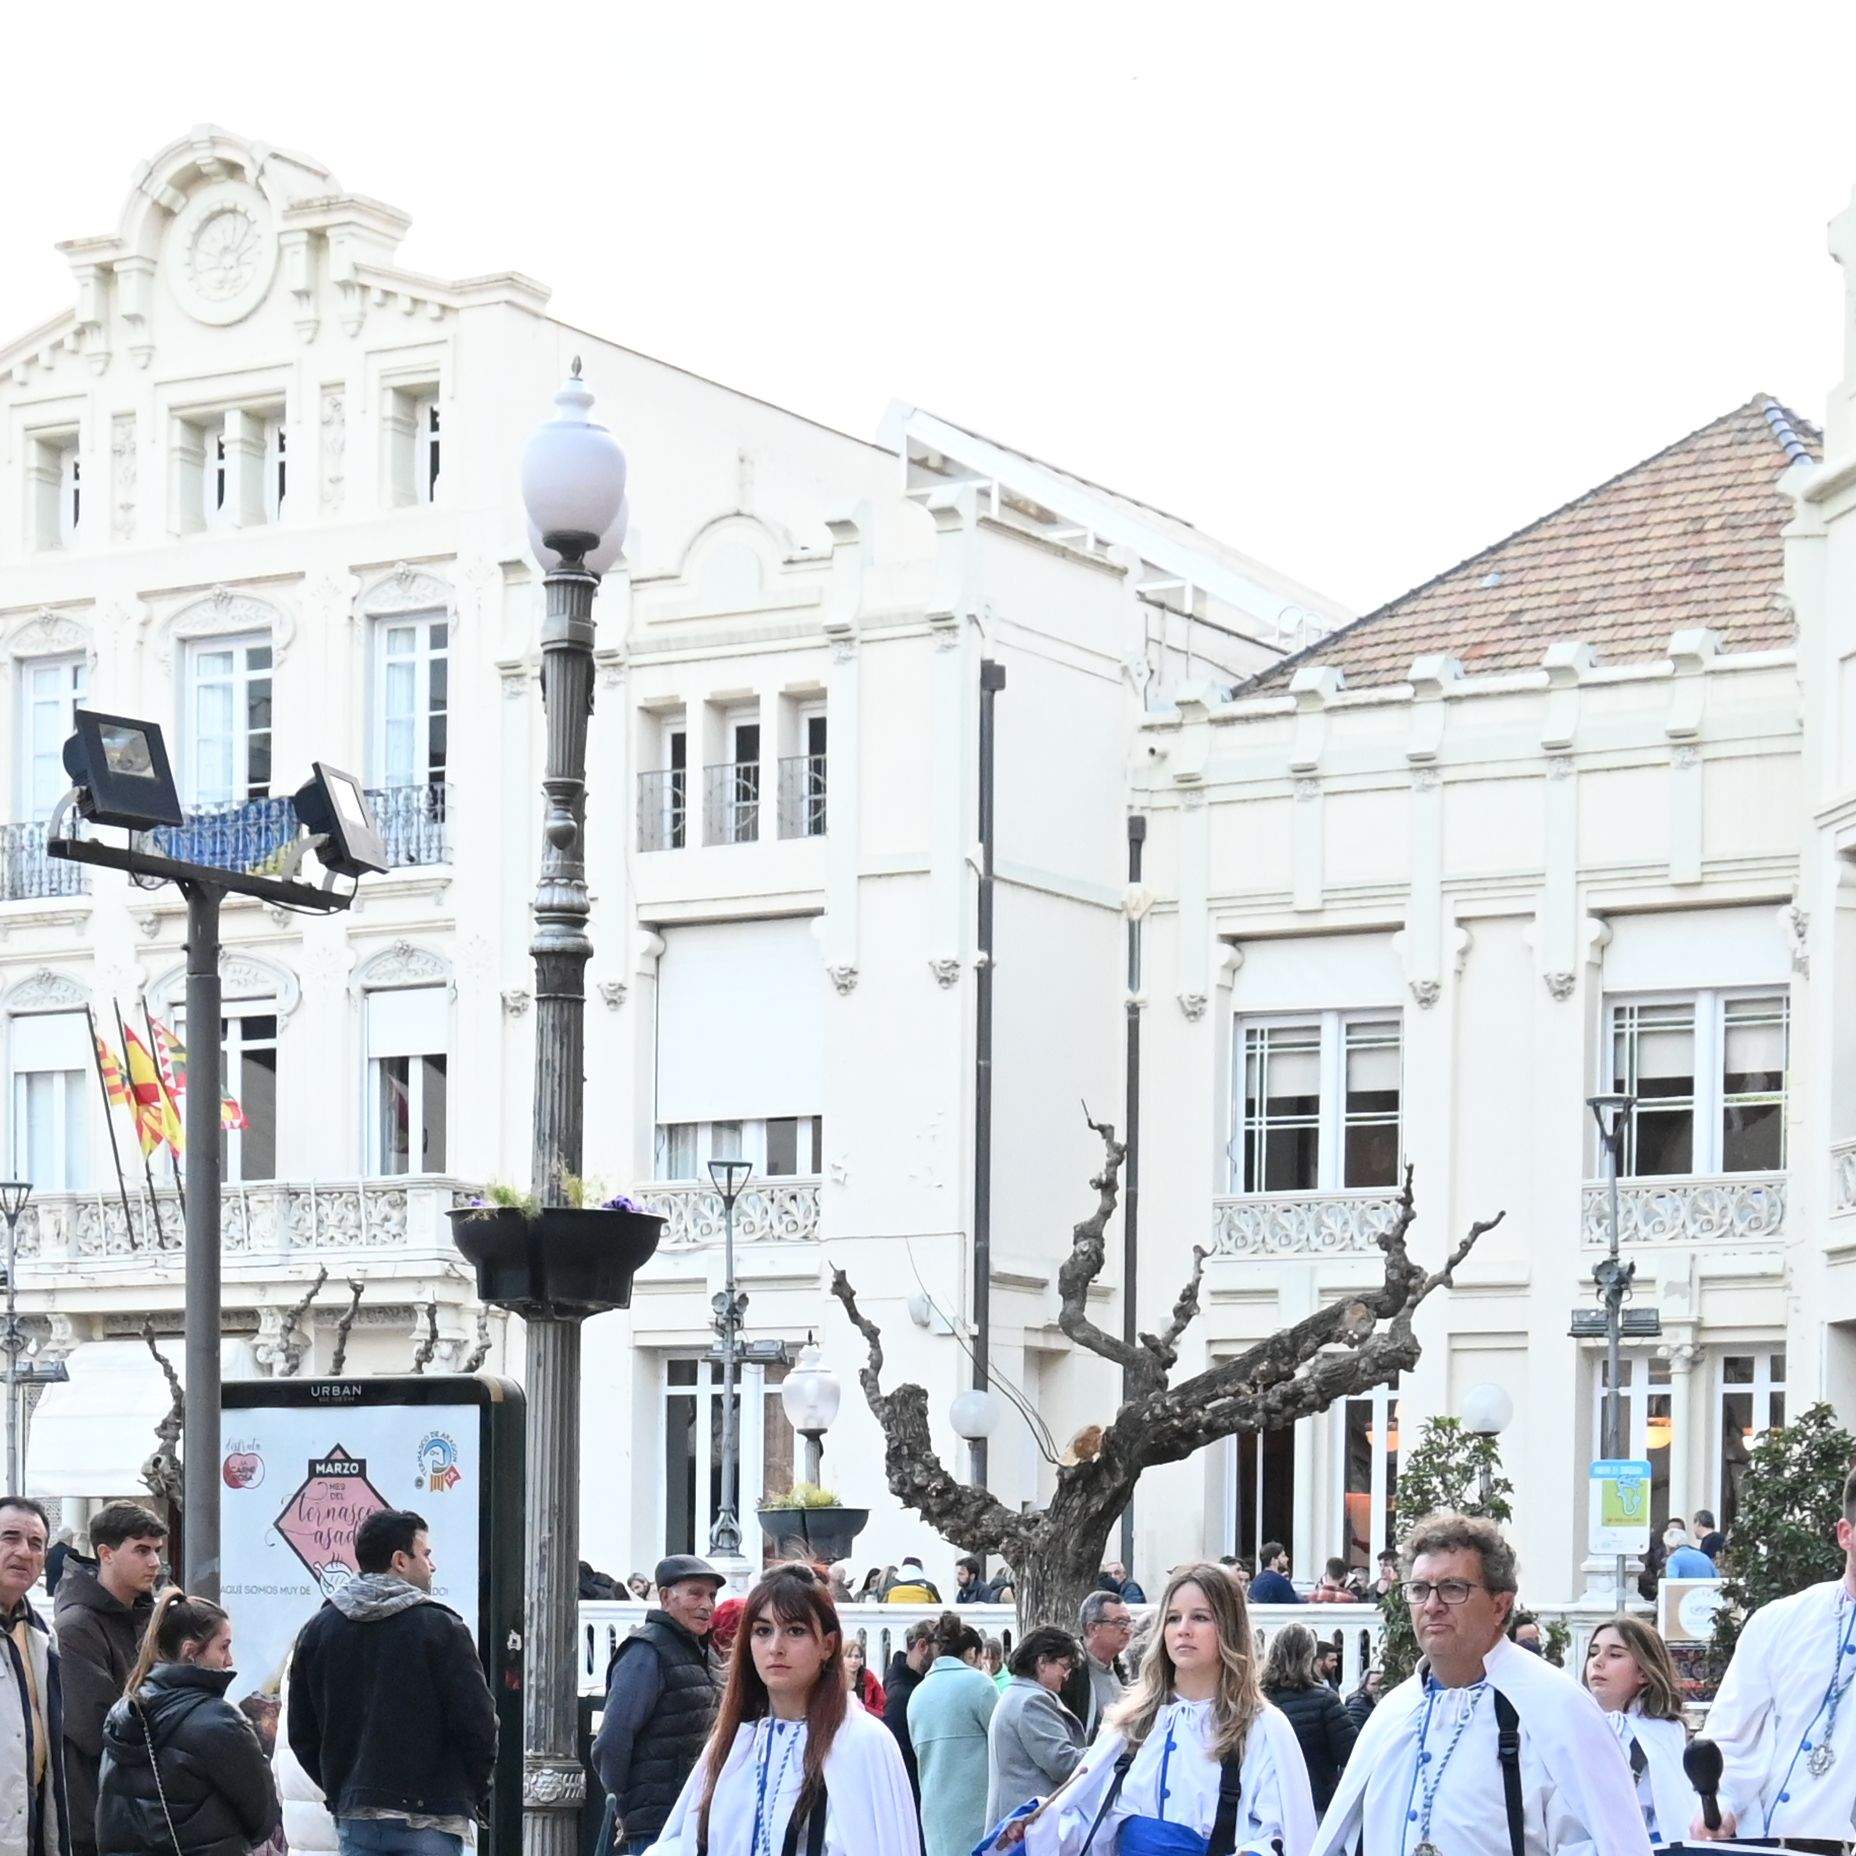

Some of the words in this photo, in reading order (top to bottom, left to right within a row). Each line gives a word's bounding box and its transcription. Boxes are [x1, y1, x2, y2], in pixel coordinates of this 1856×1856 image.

[310, 1384, 362, 1397] URBAN
[315, 1462, 359, 1474] MARZO
[329, 1483, 346, 1491] MES
[330, 1492, 344, 1500] DEL
[314, 1521, 358, 1550] asad
[244, 1585, 278, 1595] SOMOS
[280, 1585, 298, 1595] MUY
[300, 1585, 311, 1595] DE
